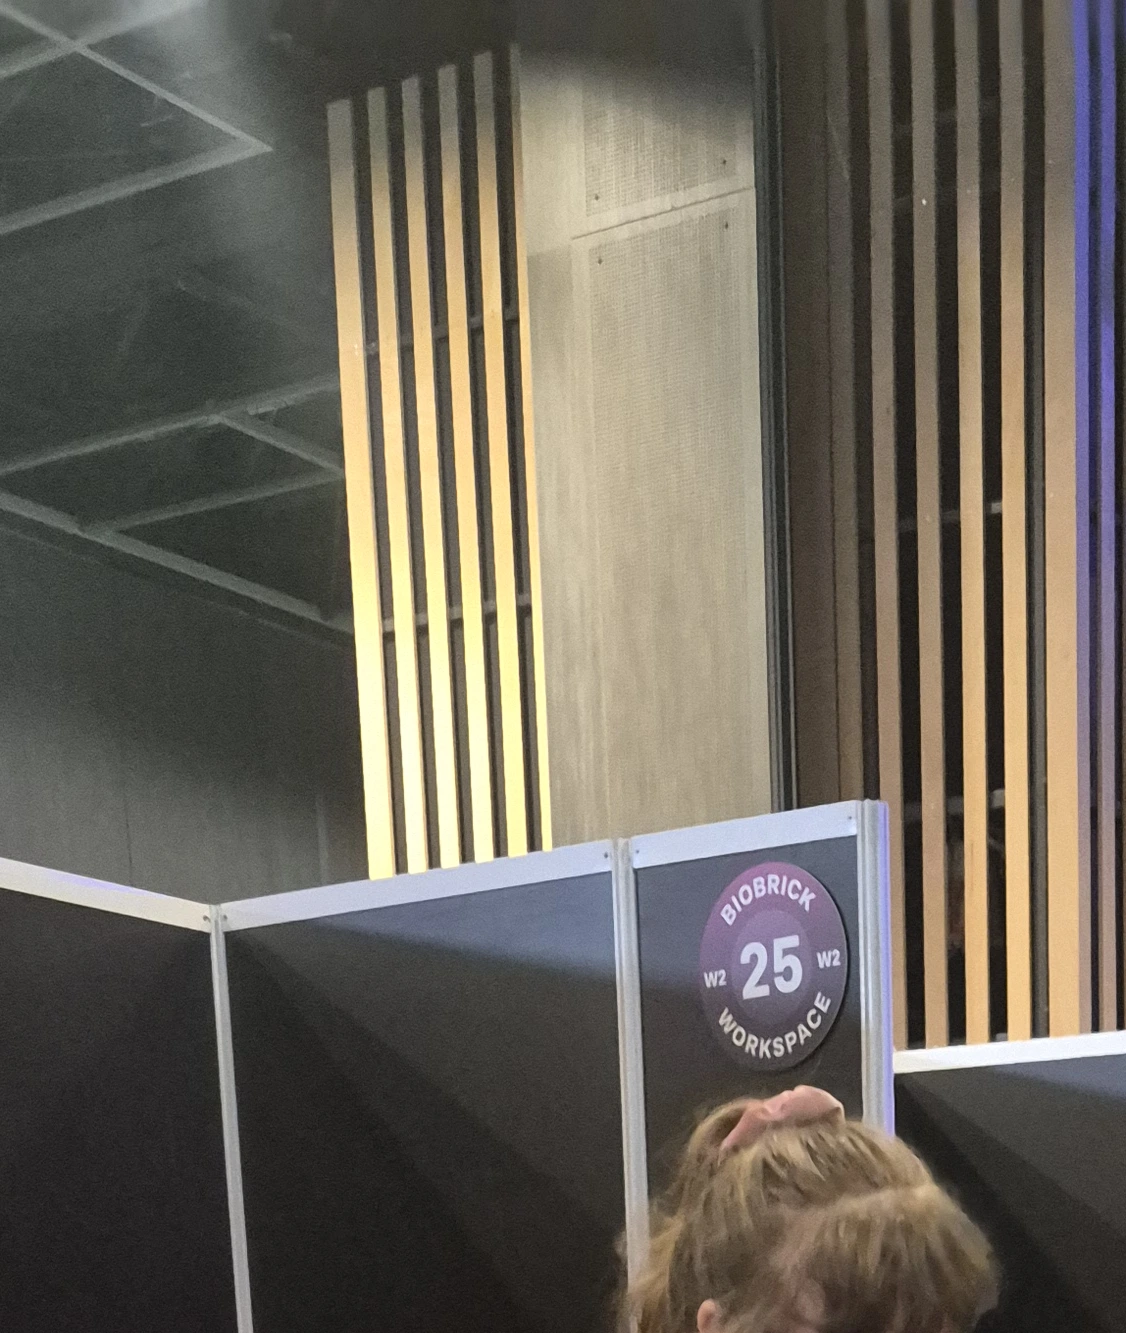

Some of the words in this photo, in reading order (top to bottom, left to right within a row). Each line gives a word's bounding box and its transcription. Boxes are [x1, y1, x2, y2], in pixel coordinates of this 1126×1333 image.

[720, 873, 816, 926] BIOBRICK
[703, 969, 727, 988] W2
[740, 934, 803, 1000] 25
[816, 949, 841, 969] W2
[718, 991, 831, 1060] WORKSPACE
